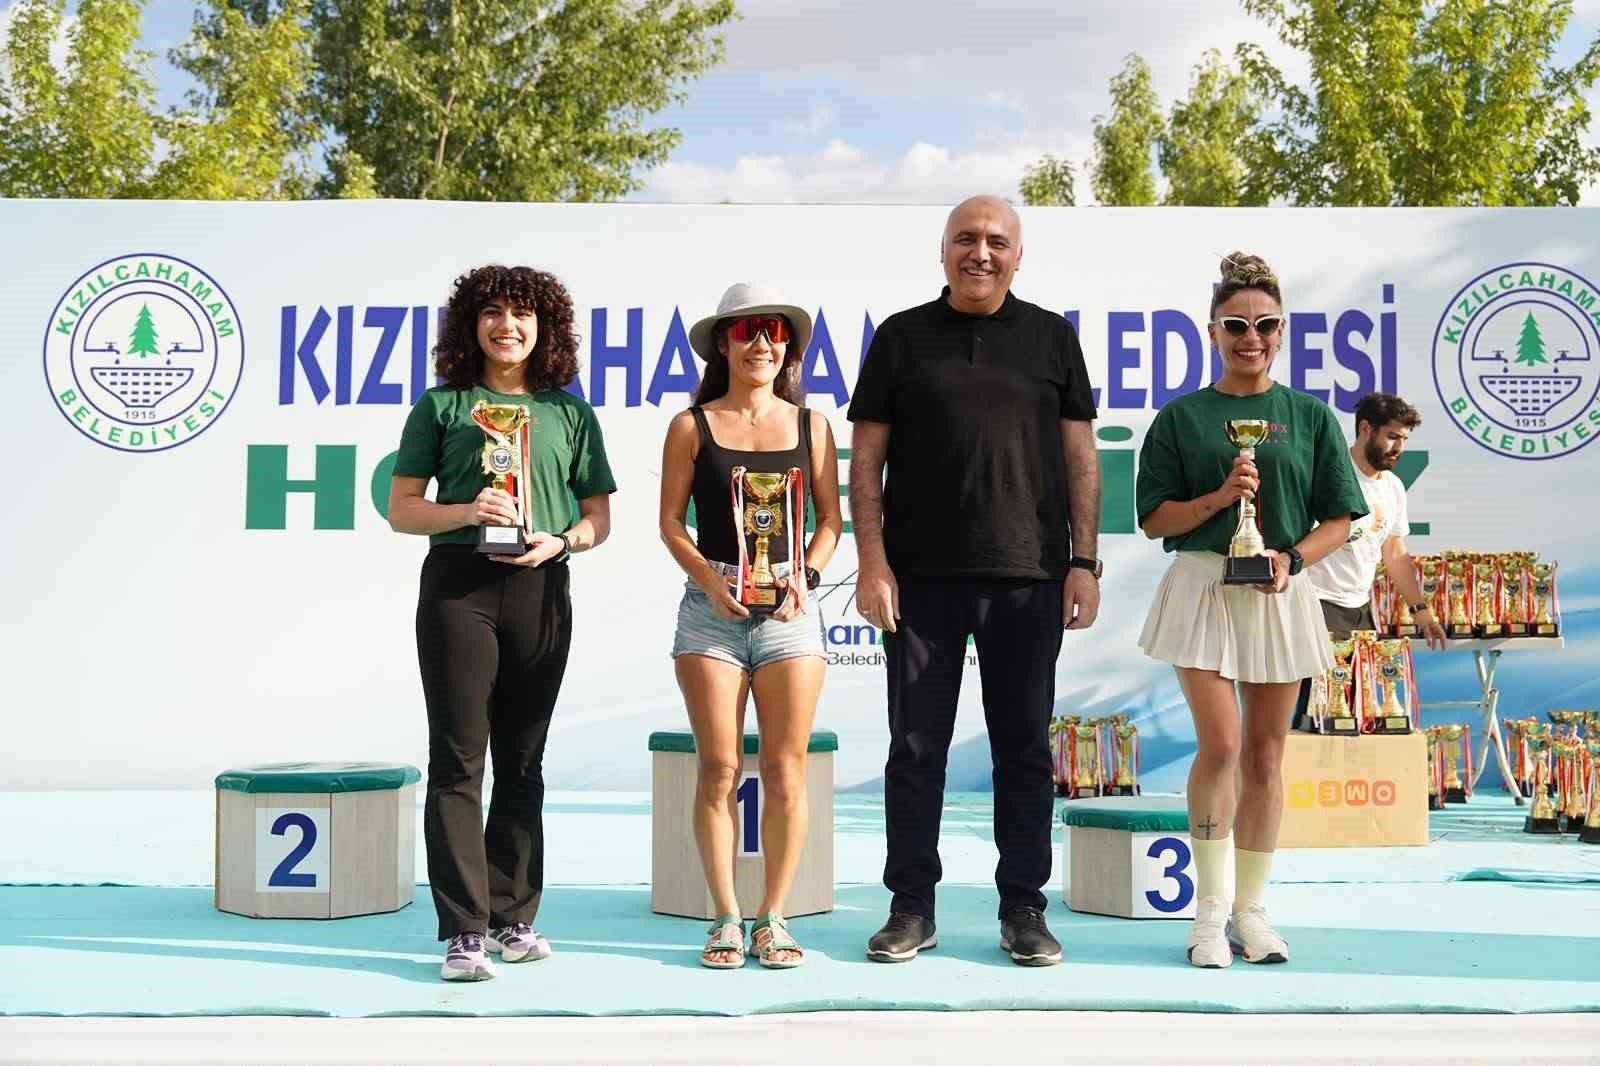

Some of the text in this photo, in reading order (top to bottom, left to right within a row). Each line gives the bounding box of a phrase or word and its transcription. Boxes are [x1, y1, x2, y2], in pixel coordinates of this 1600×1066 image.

[56, 262, 234, 338] KIZILCAHAMAM
[60, 389, 225, 446] BELEDİYESİ
[124, 410, 156, 420] 1915
[1514, 418, 1547, 428] 1915
[268, 813, 317, 887] 2
[736, 777, 759, 853] 1
[1145, 837, 1194, 913] 3
